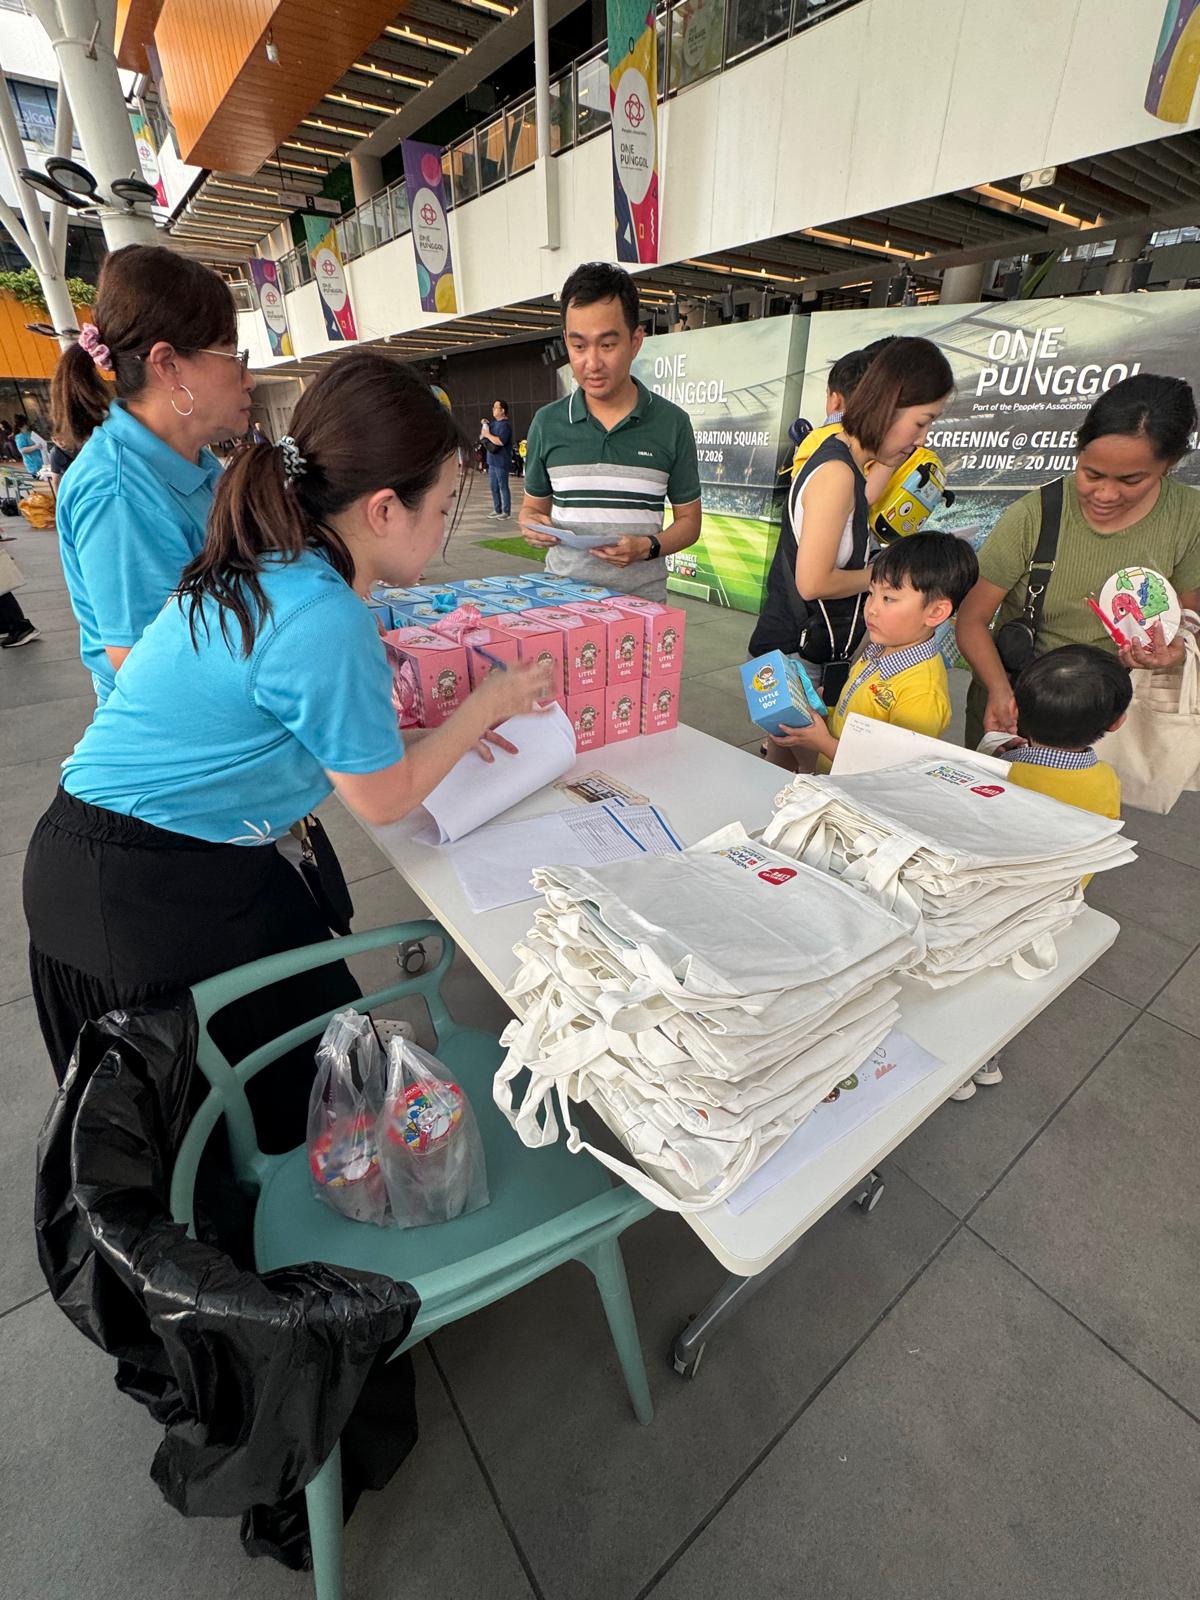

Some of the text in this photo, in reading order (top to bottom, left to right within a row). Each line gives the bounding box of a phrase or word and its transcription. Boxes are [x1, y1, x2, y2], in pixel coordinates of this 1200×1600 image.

[988, 327, 1065, 361] ONE
[654, 354, 687, 379] ONE
[972, 402, 1092, 412] Part of the People's Association
[693, 431, 769, 447] EBRATION SQUARE
[925, 431, 1010, 448] SCREENING
[1012, 433, 1027, 450] @
[705, 450, 723, 463] 2026
[961, 455, 976, 469] 12
[978, 455, 1015, 469] JUNE
[1024, 455, 1042, 470] 20
[1044, 455, 1079, 471] JULY
[659, 654, 675, 662] LITTLE
[578, 670, 596, 678] LITTLE
[758, 691, 780, 703] LITTLE
[762, 699, 777, 710] BOY
[654, 713, 670, 721] LITTLE
[614, 721, 631, 729] LITTLE
[577, 731, 595, 739] LITTLE
